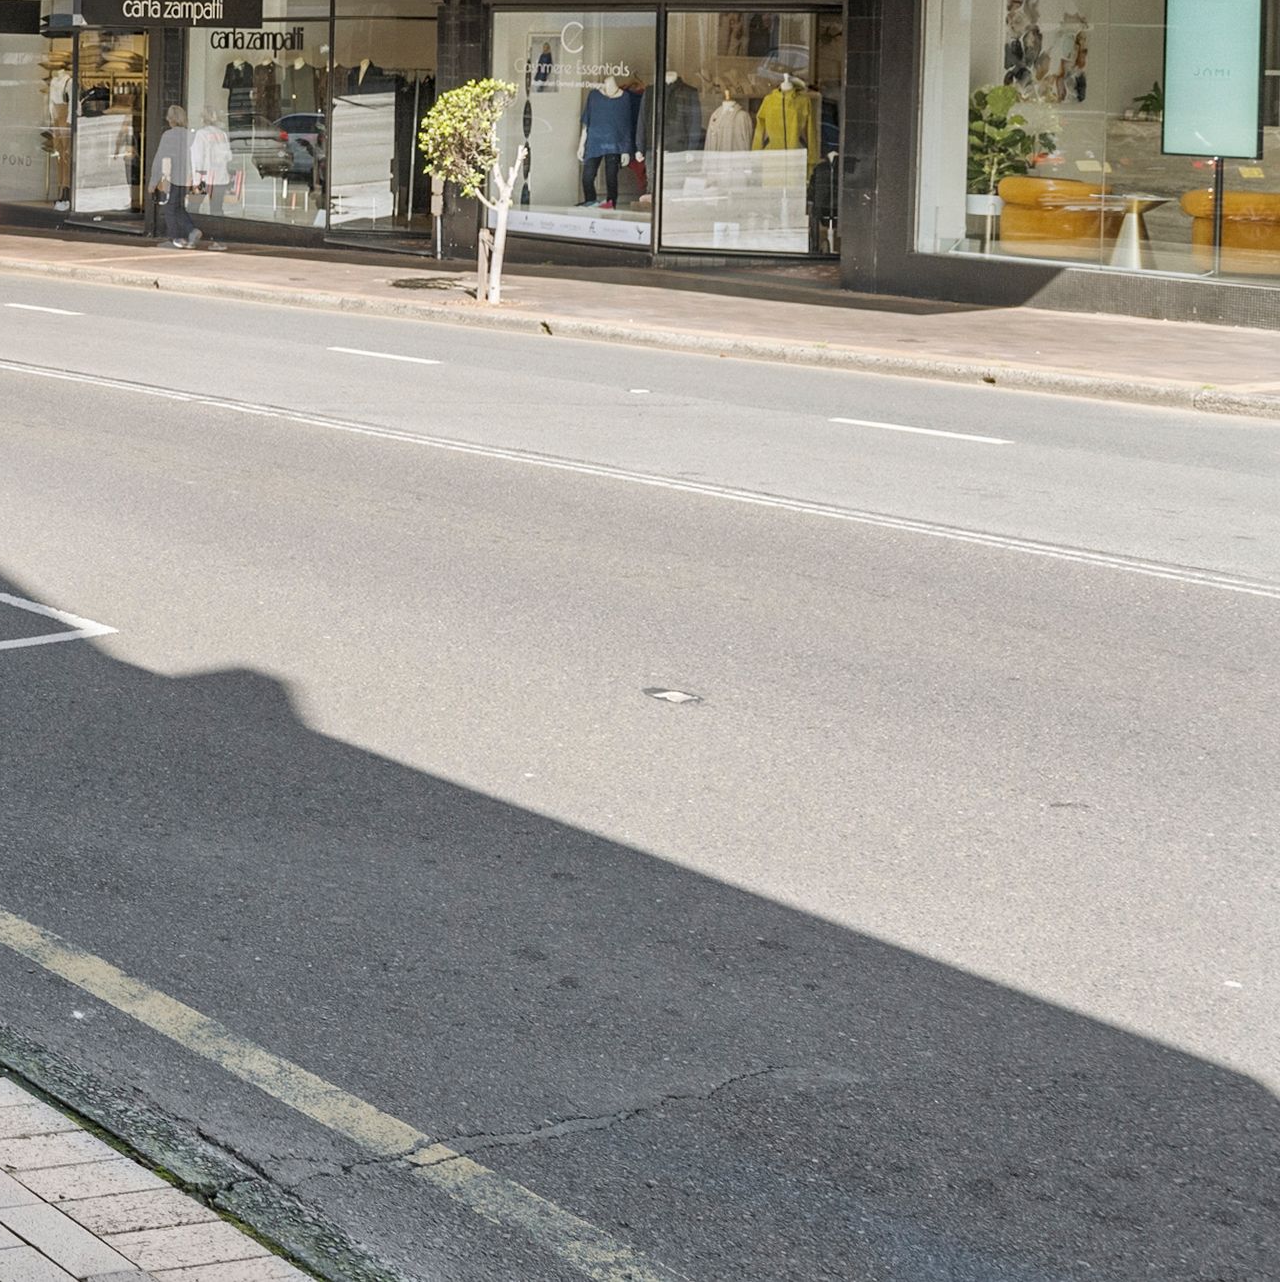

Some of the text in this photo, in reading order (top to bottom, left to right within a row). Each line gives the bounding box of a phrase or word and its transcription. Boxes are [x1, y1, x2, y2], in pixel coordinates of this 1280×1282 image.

[164, 0, 223, 25] zampatti
[210, 27, 304, 58] carla zampatti
[576, 59, 630, 77] Essentials
[1, 153, 32, 166] POND
